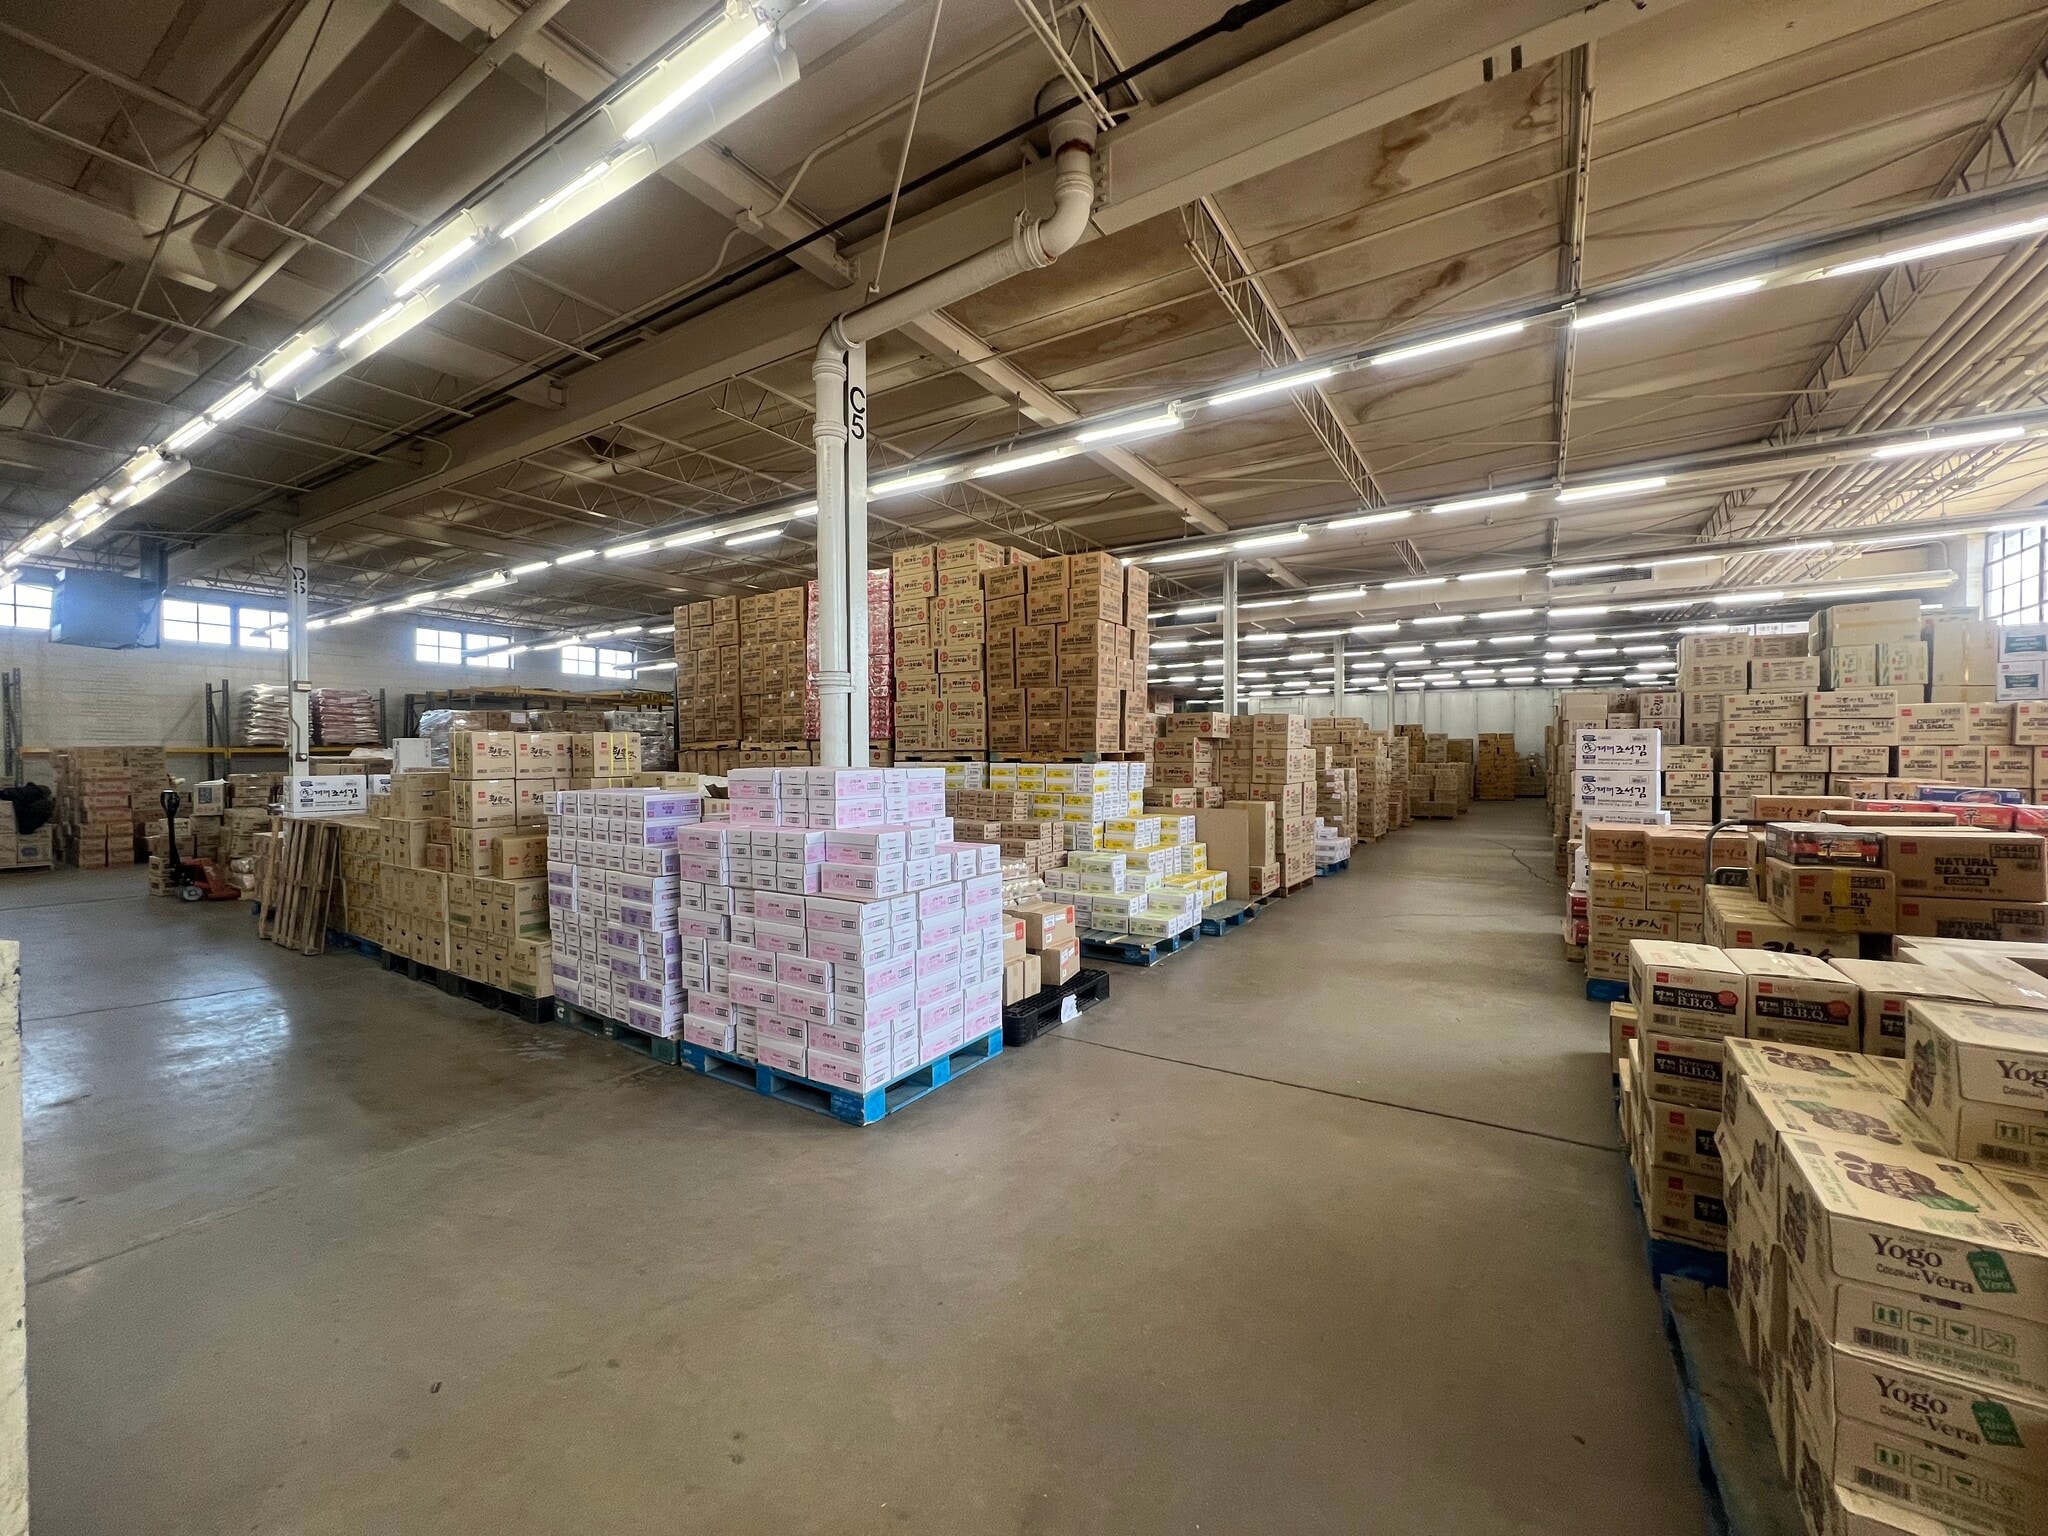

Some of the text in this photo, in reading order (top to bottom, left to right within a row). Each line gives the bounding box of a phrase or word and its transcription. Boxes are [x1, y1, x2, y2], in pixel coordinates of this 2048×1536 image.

[850, 386, 865, 439] C5
[1935, 857, 1998, 867] NATURAL
[1934, 867, 1999, 877] SEA SALT
[1823, 891, 1871, 901] NRAL
[1678, 989, 1713, 1000] Korean
[1677, 996, 1717, 1010] B.B.Q.
[1783, 1000, 1822, 1010] Korean
[1783, 1006, 1828, 1021] B.B.Q.
[1679, 1058, 1714, 1069] Korean
[1679, 1065, 1719, 1080] B.B.Q.
[1996, 1060, 2048, 1088] Yog
[1869, 1233, 1943, 1269] Yogo
[1921, 1268, 1975, 1295] Vera
[1872, 1373, 1948, 1415] Yogo
[1925, 1416, 1983, 1446] Vera
